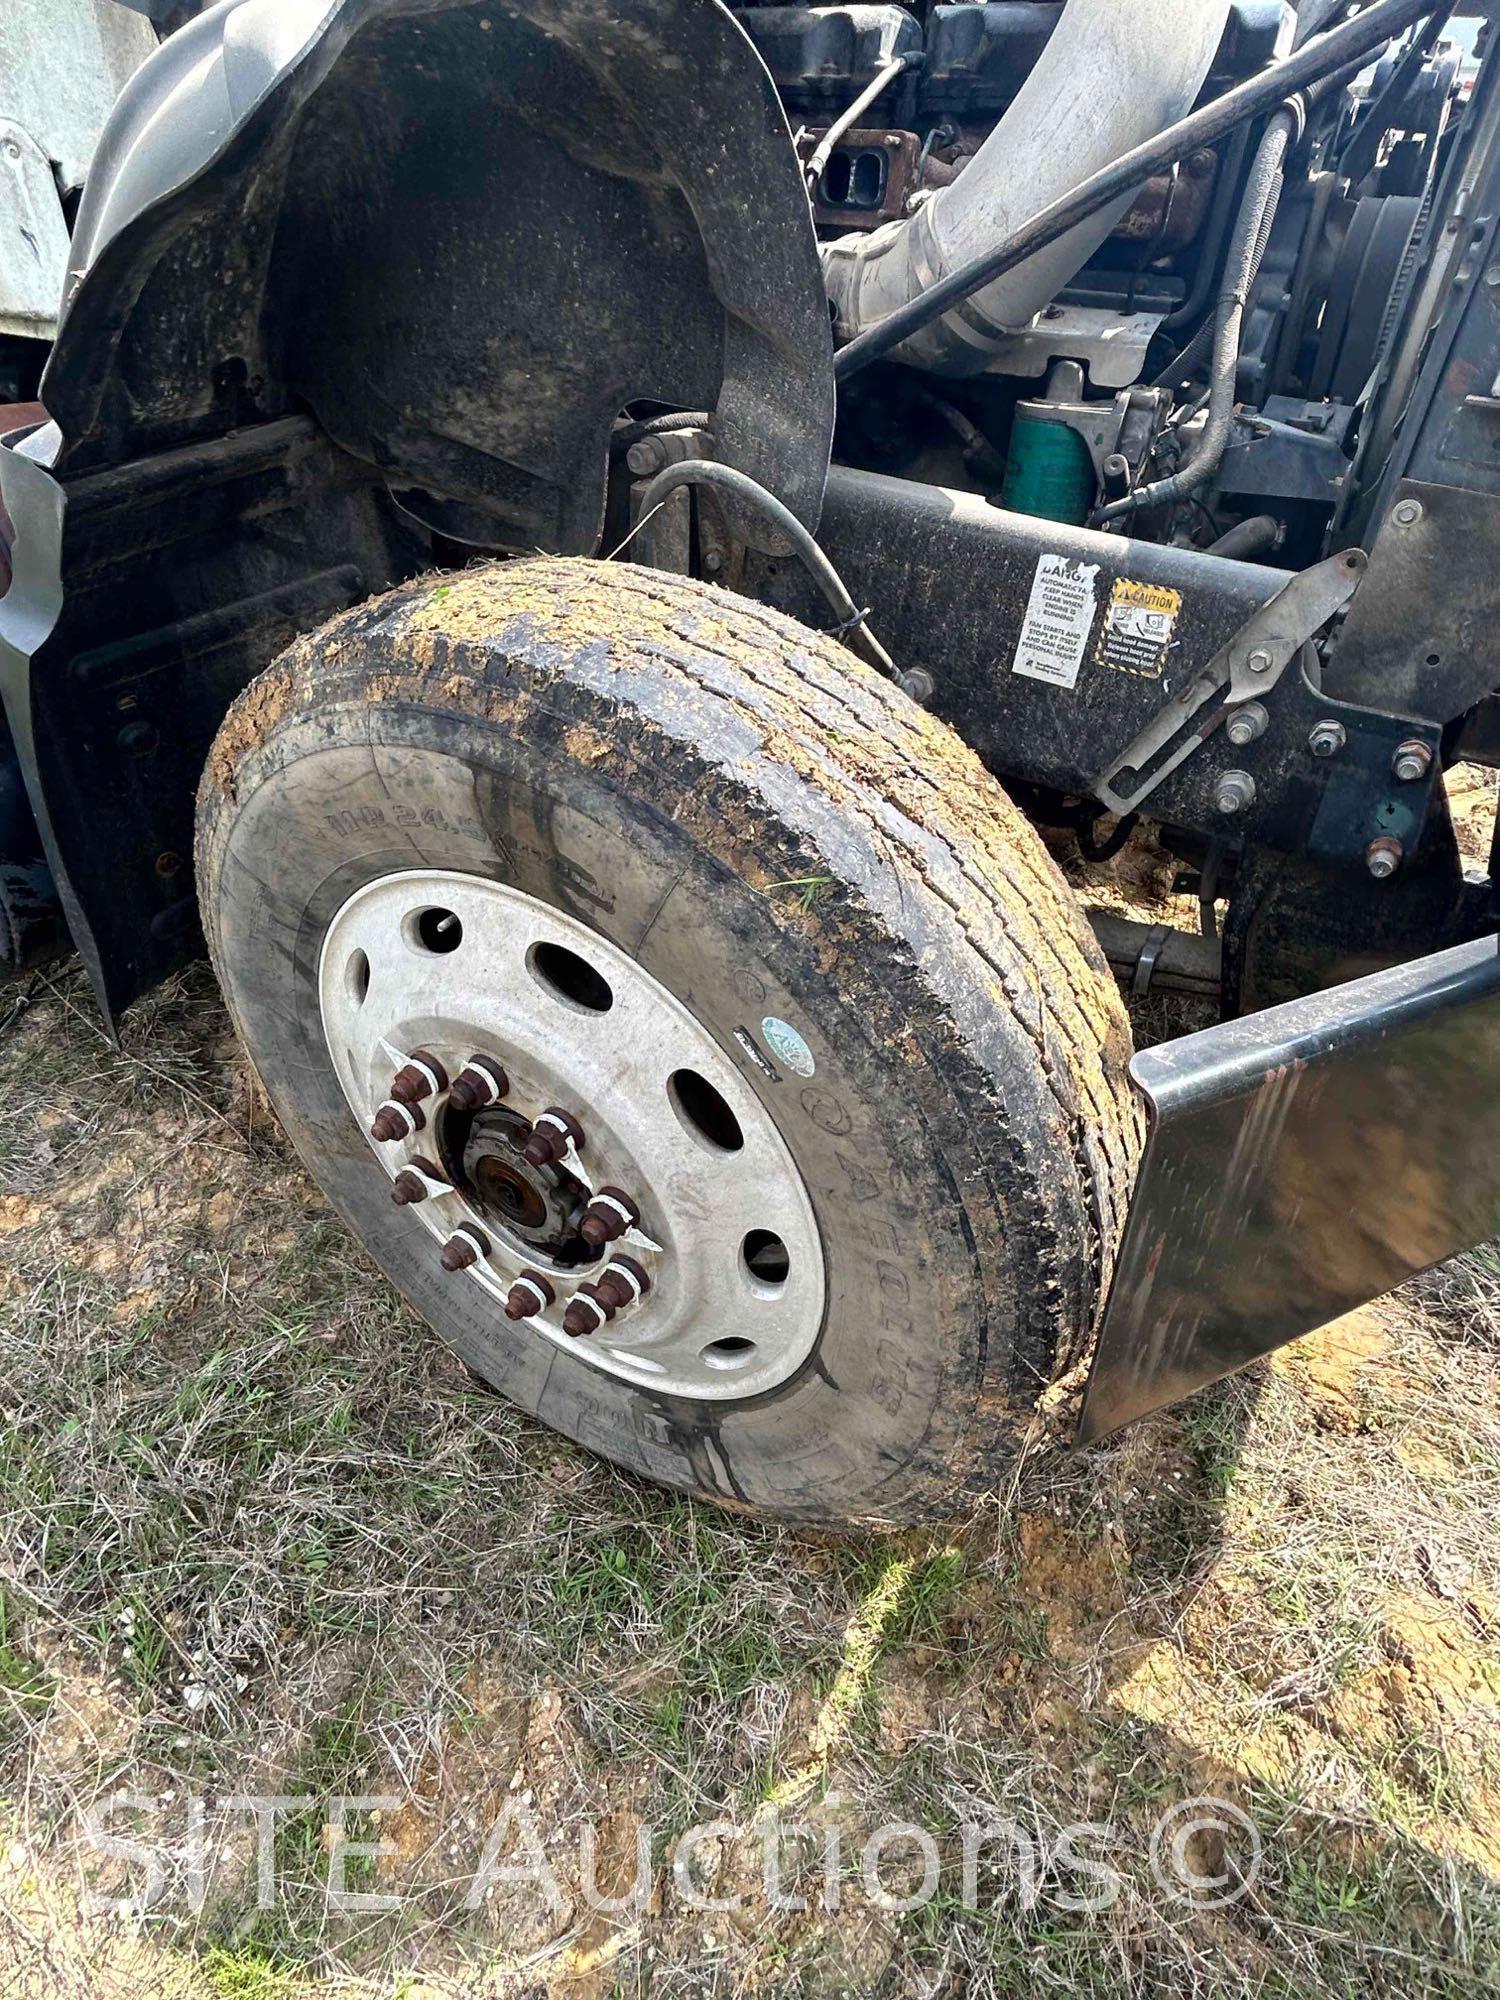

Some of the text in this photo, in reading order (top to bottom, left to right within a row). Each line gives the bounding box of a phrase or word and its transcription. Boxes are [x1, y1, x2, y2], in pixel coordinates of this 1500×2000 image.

[1042, 592, 1083, 609] CLEAR WHEN
[1044, 585, 1084, 601] KEEP HANDS
[1132, 589, 1173, 609] CAUTION
[1042, 608, 1074, 622] RUNNING
[1044, 601, 1069, 613] ENGINE
[1028, 620, 1081, 639] FAN STARTS AND
[1028, 627, 1048, 638] STOPS
[1048, 633, 1058, 641] BY
[1021, 641, 1077, 662] PERSONAL INJURY
[1025, 634, 1077, 654] AND CAN CAUSE
